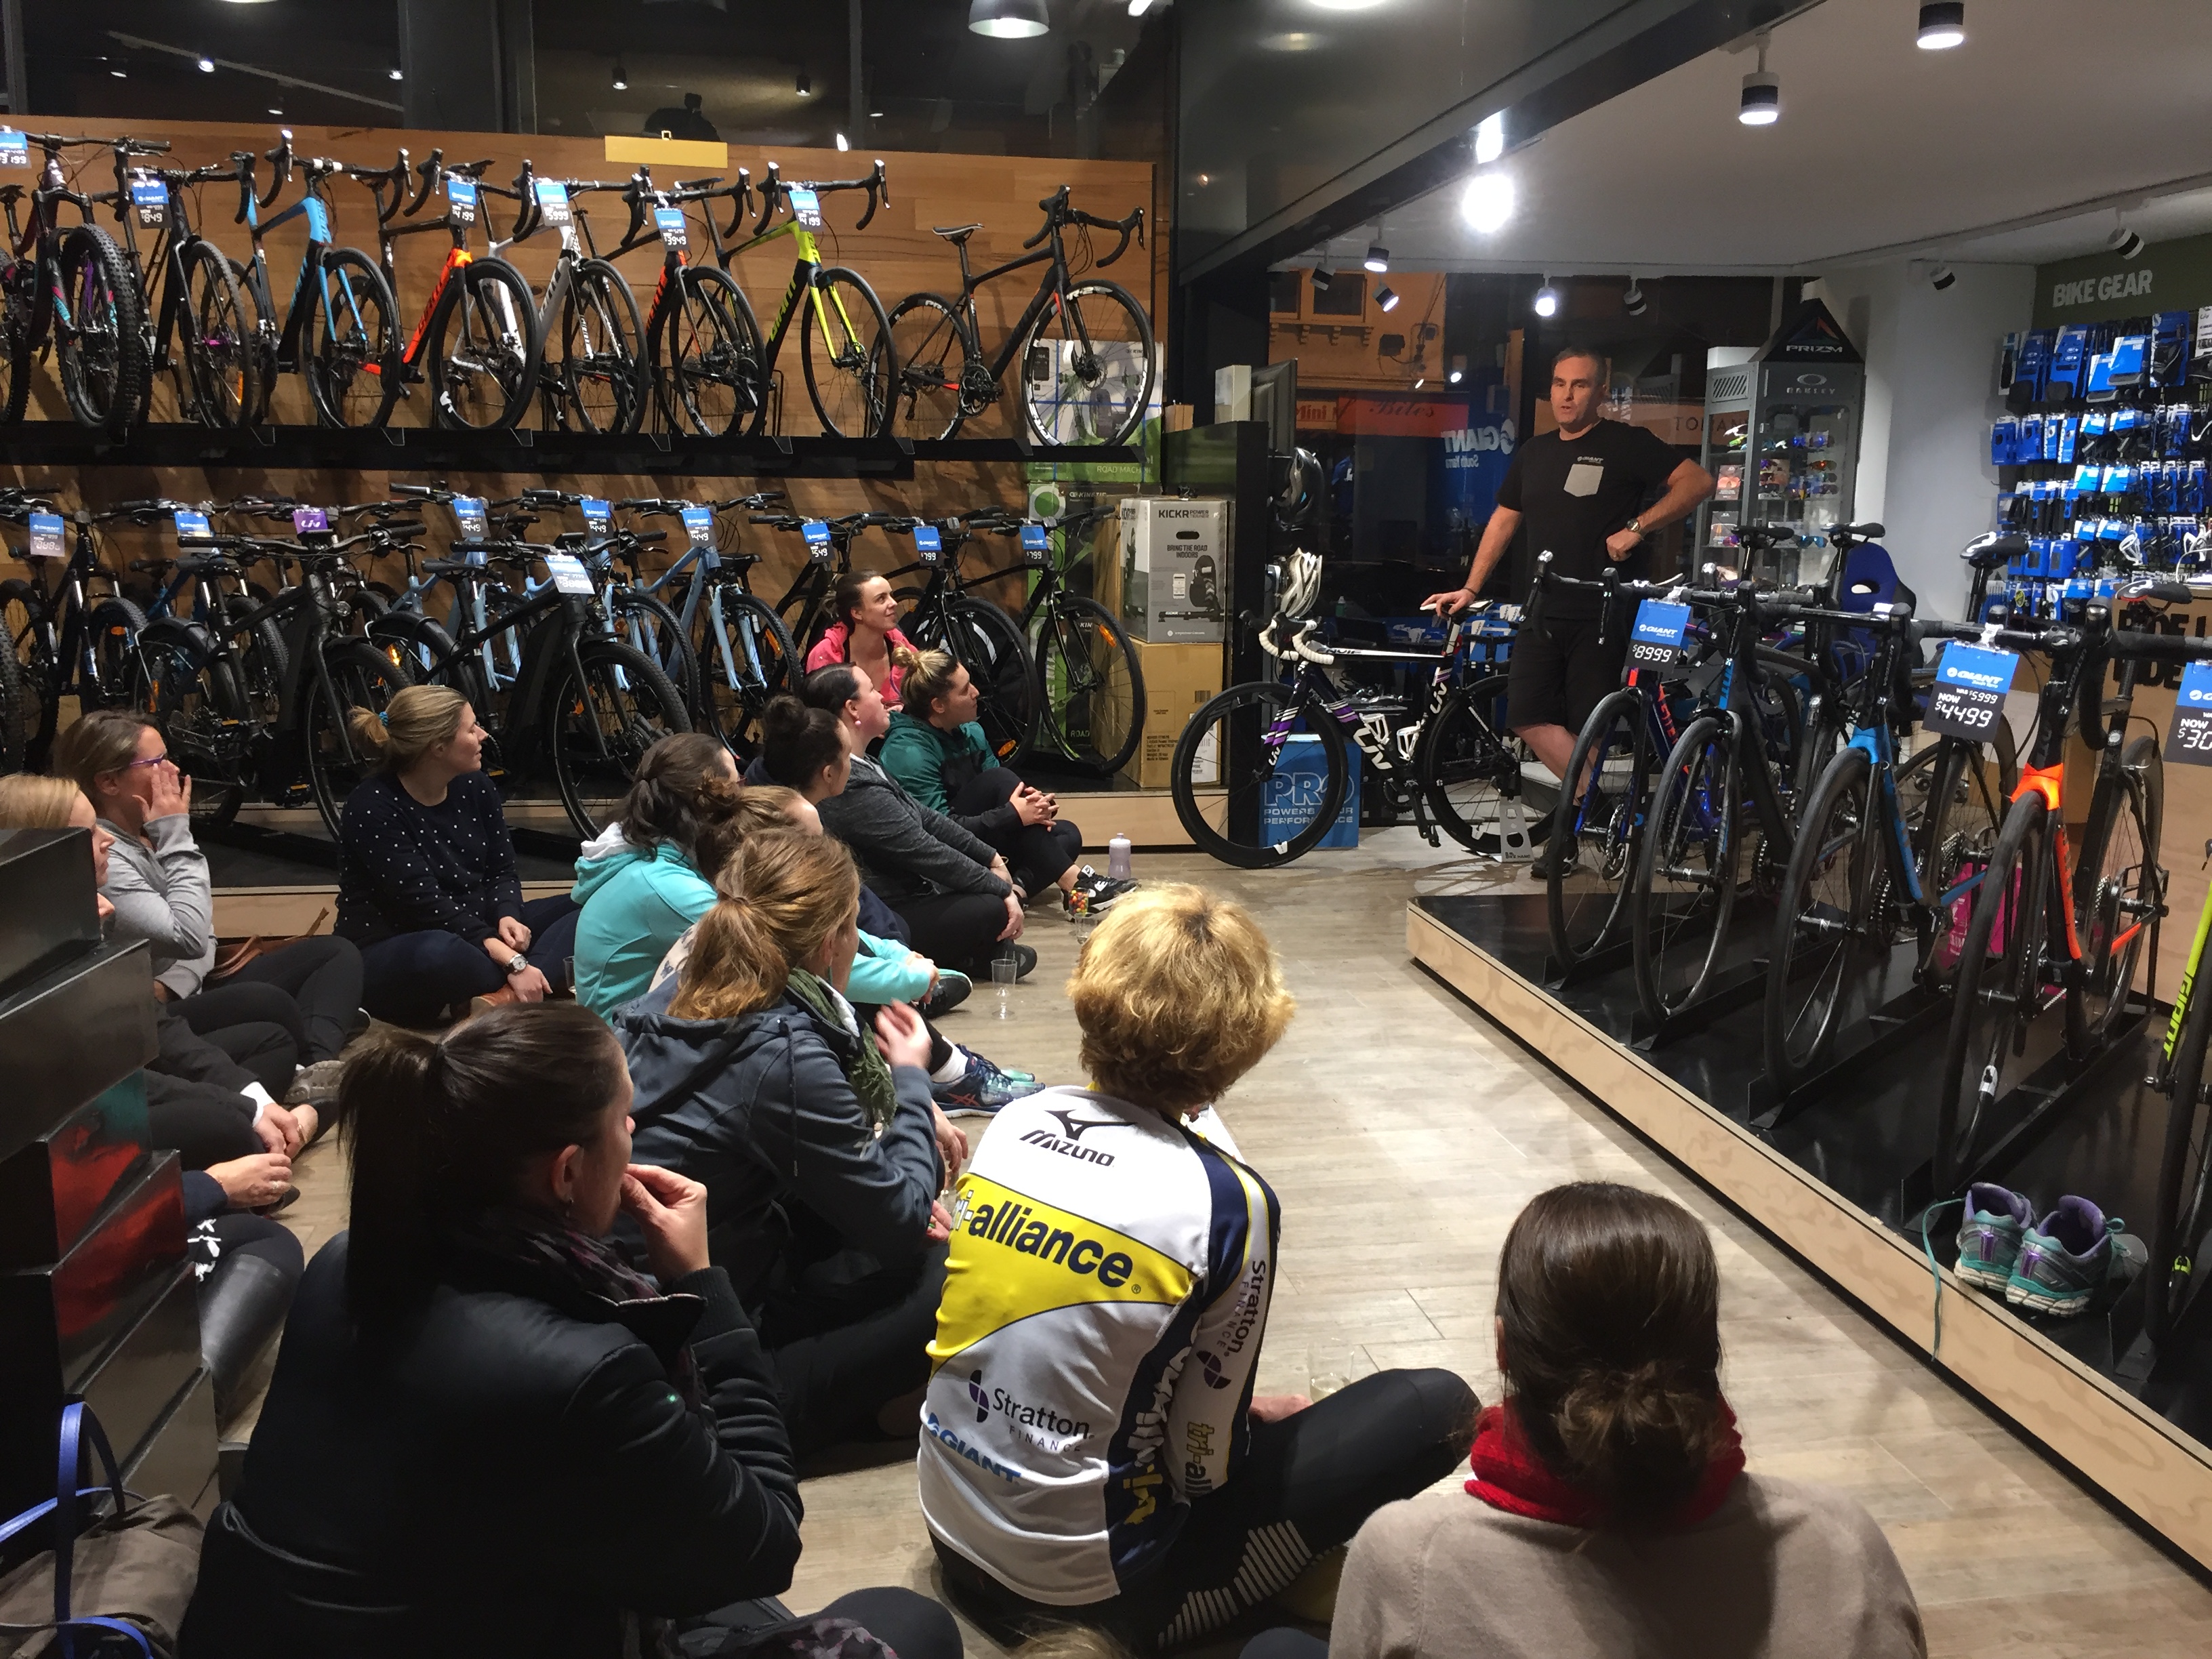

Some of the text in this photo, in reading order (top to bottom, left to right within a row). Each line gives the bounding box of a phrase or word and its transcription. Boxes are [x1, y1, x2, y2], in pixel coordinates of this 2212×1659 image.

[0, 155, 27, 164] 3199
[452, 209, 474, 222] $4199
[2052, 269, 2153, 308] BIKE GEAR
[770, 277, 796, 342] GIANT
[1786, 344, 1843, 353] PRIZM
[1158, 510, 1189, 518] KICKR
[302, 519, 321, 528] Liv
[463, 523, 481, 533] $449
[590, 524, 607, 533] $449
[691, 533, 709, 541] $449
[812, 548, 828, 558] $549
[921, 552, 937, 561] $799
[1026, 551, 1042, 560] $799
[1646, 626, 1679, 636] GIANT
[1632, 644, 1673, 663] $8999
[1957, 670, 2004, 684] GIANT
[1430, 682, 1447, 714] Liv
[1938, 693, 1961, 703] NOW
[1969, 690, 1999, 704] $5999
[1934, 700, 1993, 727] $4499
[2180, 718, 2209, 729] NOW
[2177, 727, 2212, 750] $30
[1268, 746, 1281, 766] Liv
[1353, 727, 1393, 771] Liv
[1264, 808, 1315, 816] POWERS
[1018, 1129, 1115, 1167] MIZUNO
[949, 1189, 1134, 1288] ri-alliance
[1229, 1259, 1266, 1354] Stratton
[1216, 1281, 1250, 1351] FINANCE
[992, 1387, 1090, 1440] Stratton
[1008, 1425, 1081, 1453] FINANCE
[939, 1428, 1022, 1483] GIANT
